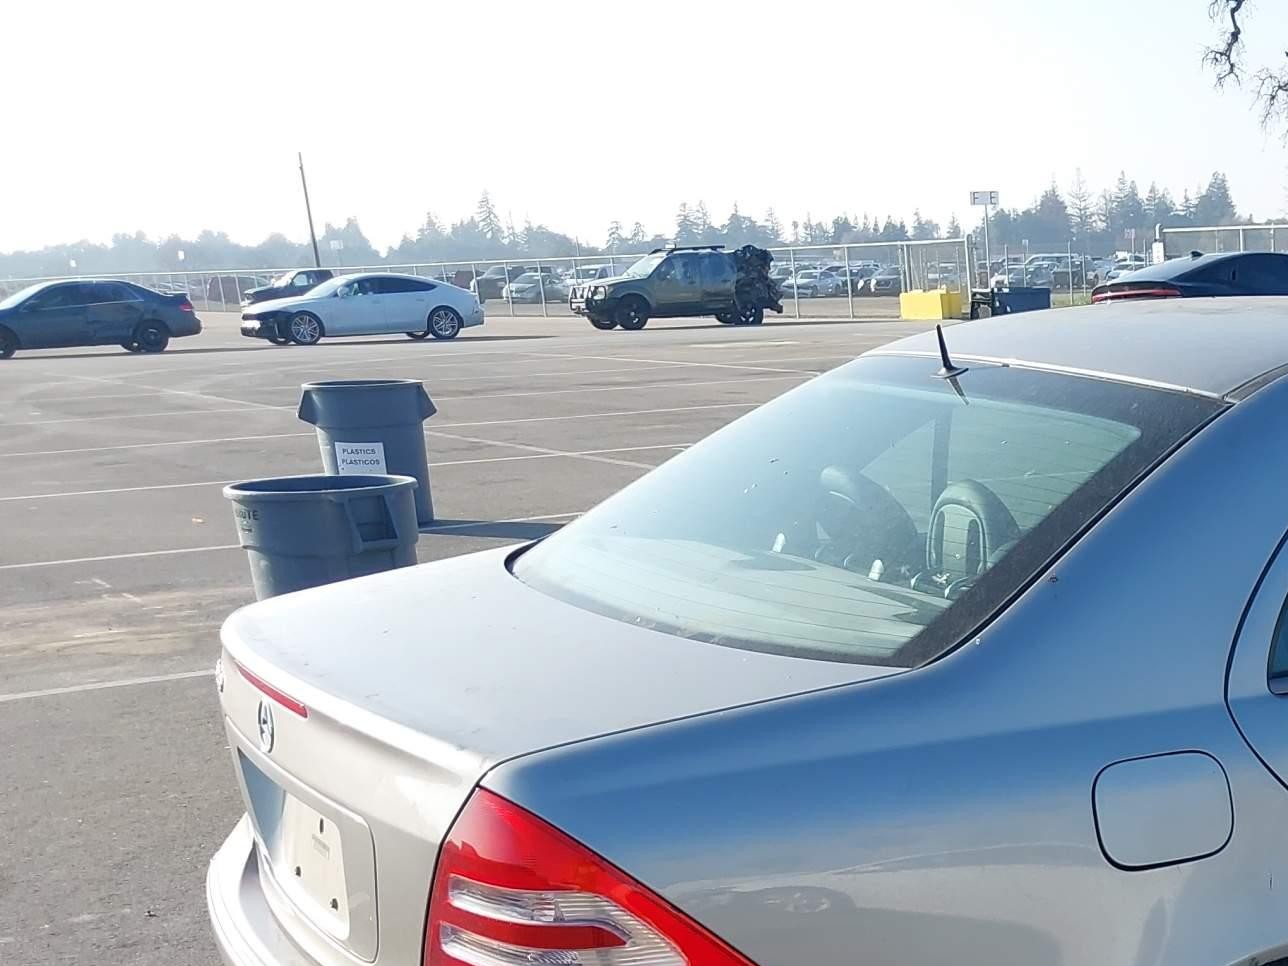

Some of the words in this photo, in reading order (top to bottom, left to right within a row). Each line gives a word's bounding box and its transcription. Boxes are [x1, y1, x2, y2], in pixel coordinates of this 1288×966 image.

[972, 192, 980, 205] F
[990, 191, 998, 205] E
[342, 447, 377, 455] PLASTICS
